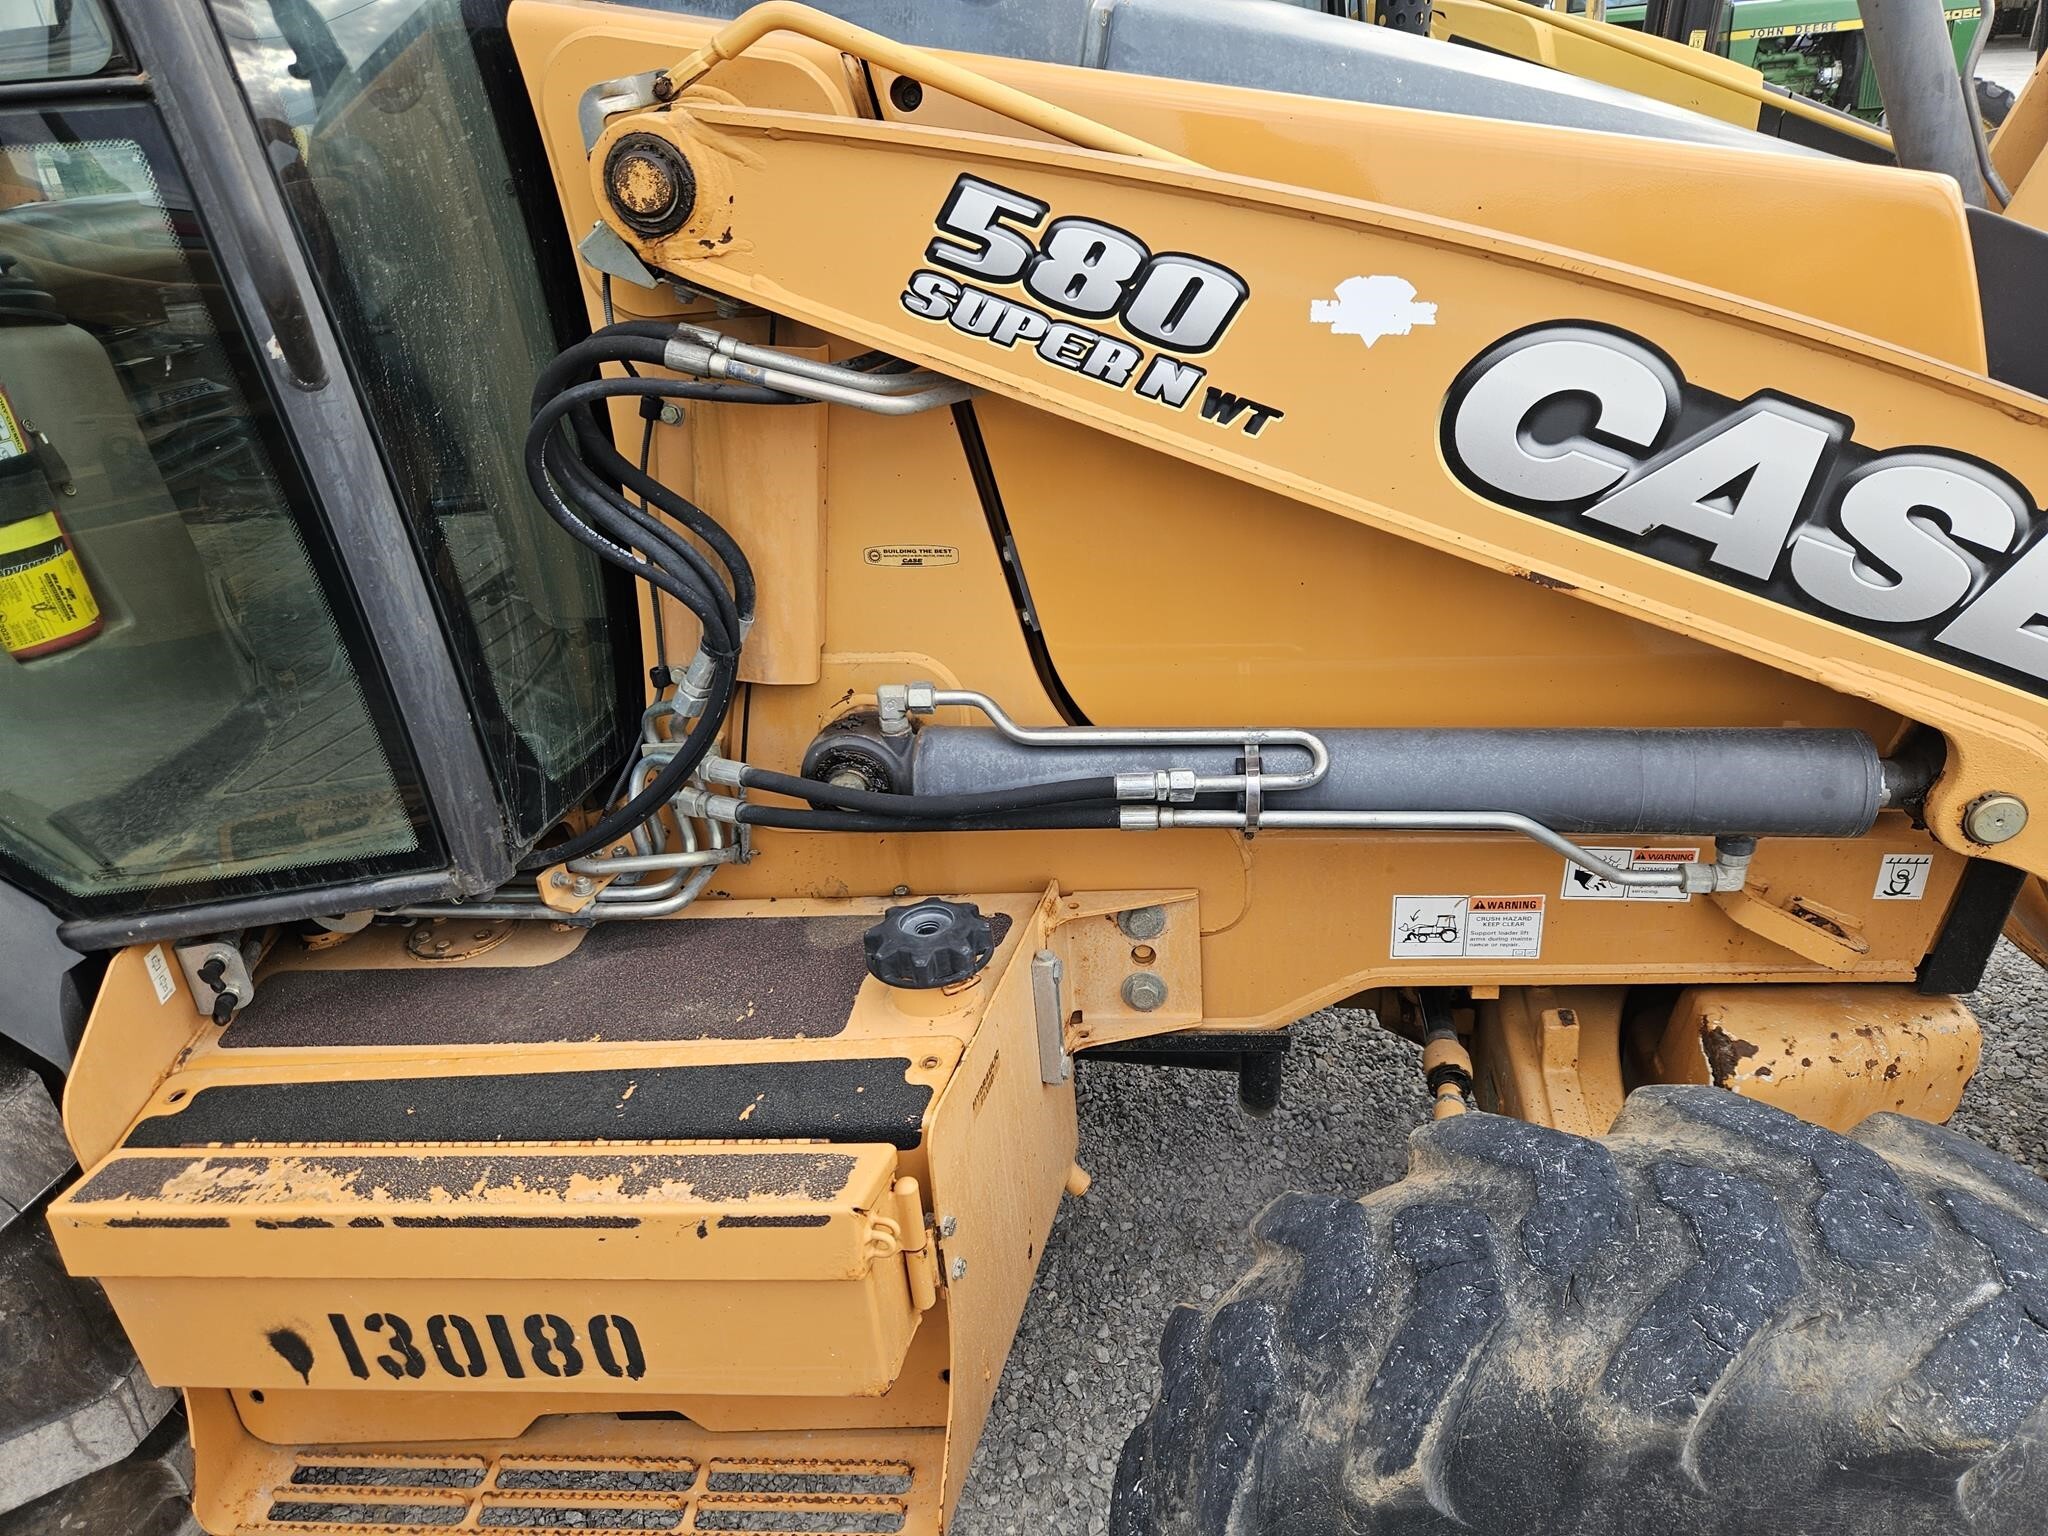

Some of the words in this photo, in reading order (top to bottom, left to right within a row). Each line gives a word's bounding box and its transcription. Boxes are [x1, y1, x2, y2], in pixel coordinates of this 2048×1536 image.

[1750, 27, 1785, 39] JOHN
[924, 172, 1250, 354] 580
[900, 269, 1144, 388] SUPER
[1134, 353, 1207, 409] N
[1202, 386, 1284, 436] WT
[1647, 853, 1695, 861] WARNING
[1487, 900, 1537, 910] WARNING
[327, 1312, 647, 1382] 130180
